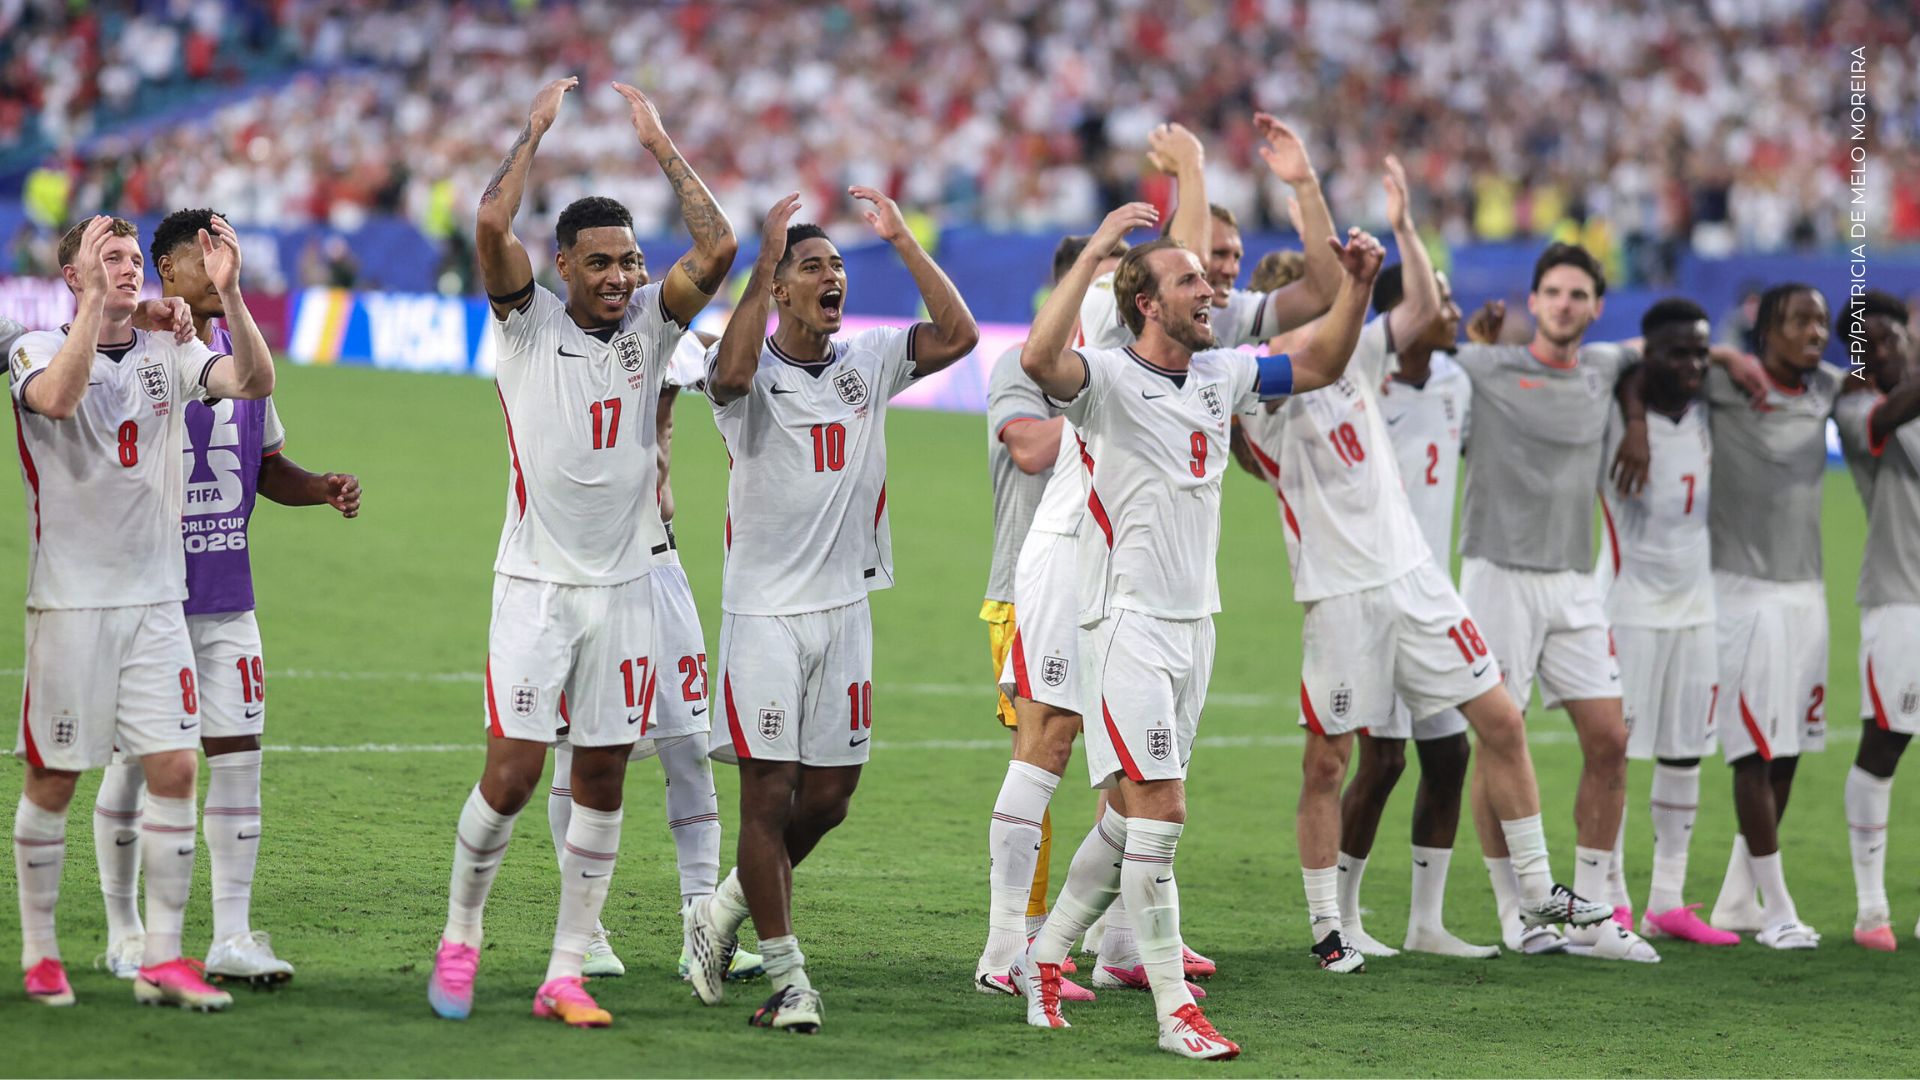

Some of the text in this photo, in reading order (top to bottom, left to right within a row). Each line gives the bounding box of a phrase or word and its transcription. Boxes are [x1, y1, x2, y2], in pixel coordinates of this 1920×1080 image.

[117, 420, 138, 467] 8
[589, 398, 622, 449] 17
[1329, 421, 1366, 467] 18
[810, 422, 846, 472] 10
[1190, 431, 1208, 477] 9
[1426, 442, 1438, 486] 2
[187, 488, 223, 504] FIFA
[1681, 474, 1695, 514] 7
[181, 517, 245, 533] ORLD CUP
[184, 531, 247, 553] 026
[1448, 618, 1488, 664] 18
[179, 667, 198, 715] 8
[236, 656, 265, 703] 19
[619, 656, 648, 708] 17
[677, 653, 708, 702] 25
[848, 680, 872, 730] 10
